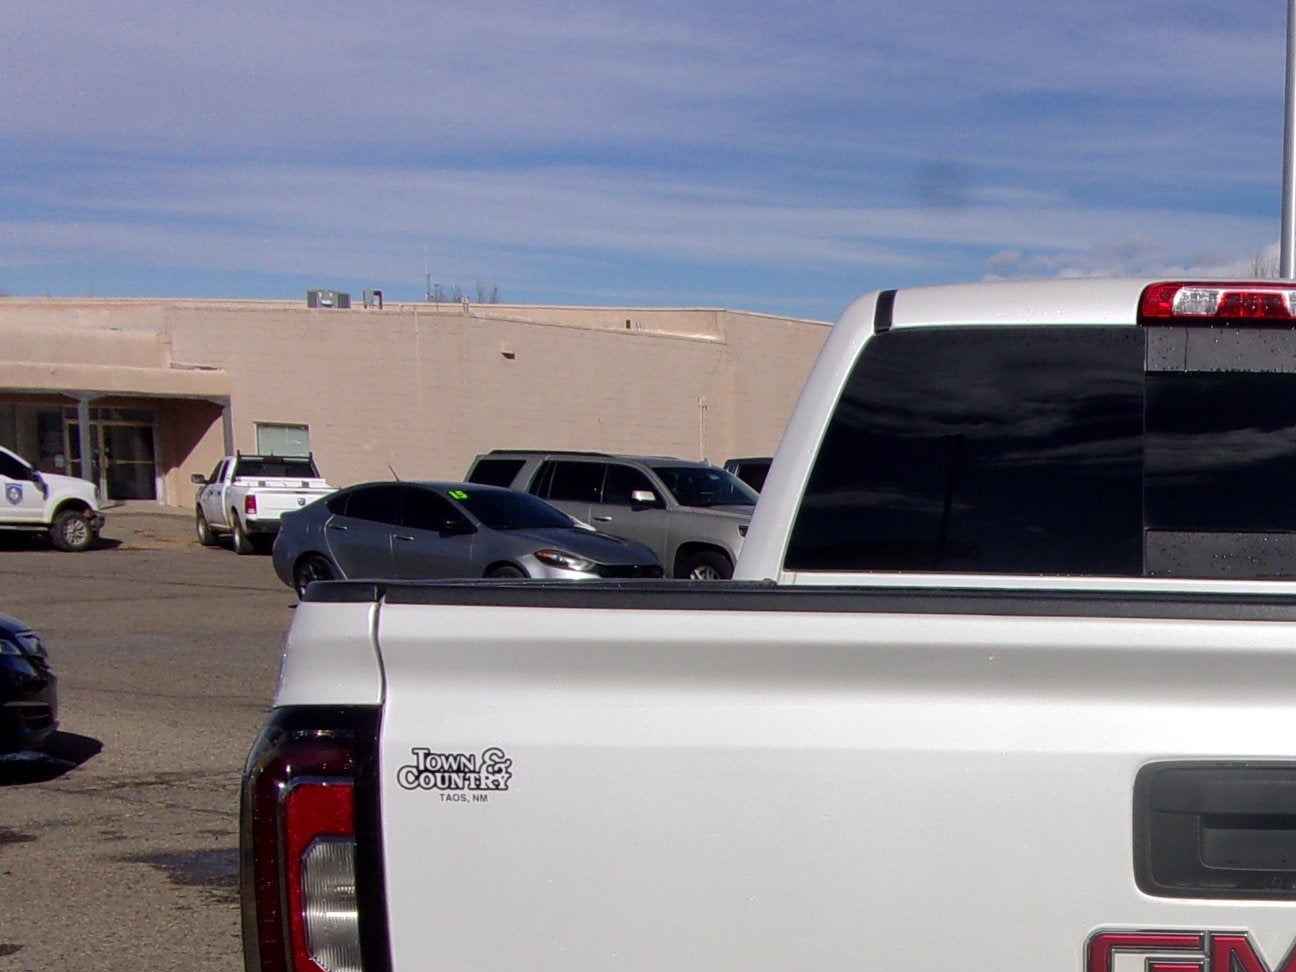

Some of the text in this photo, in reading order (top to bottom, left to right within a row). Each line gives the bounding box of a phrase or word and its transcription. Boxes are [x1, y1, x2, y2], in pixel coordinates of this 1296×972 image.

[480, 747, 513, 775] &
[397, 765, 512, 790] COUNTRY
[440, 793, 488, 803] TAOS, NM
